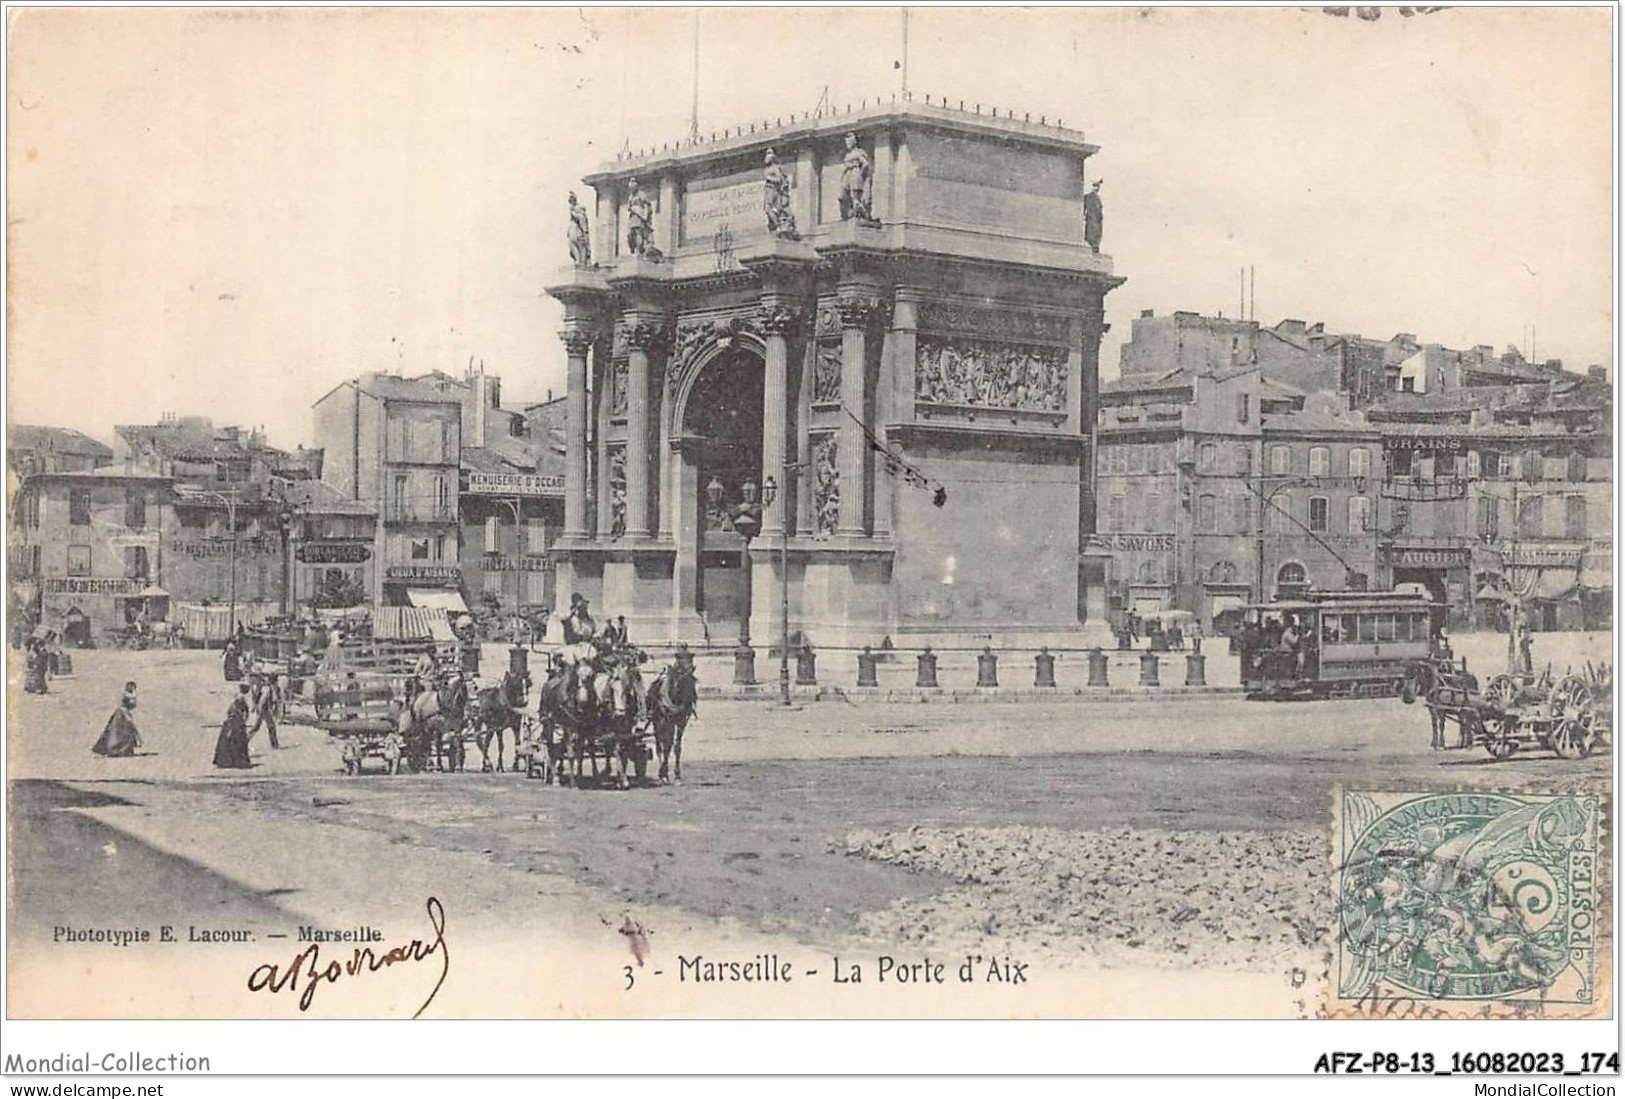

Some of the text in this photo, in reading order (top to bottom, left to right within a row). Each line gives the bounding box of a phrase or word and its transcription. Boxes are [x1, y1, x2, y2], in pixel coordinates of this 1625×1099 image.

[1387, 438, 1461, 450] GRAINS
[471, 474, 522, 487] MENUISERIE
[1117, 536, 1175, 552] SAVONS
[1571, 854, 1593, 945] POSTES
[54, 926, 150, 945] Phototypie
[160, 926, 177, 942] E.
[189, 926, 256, 942] Lacour.
[298, 926, 385, 943] Marseille.
[623, 964, 635, 990] 3
[678, 955, 792, 983] Marseille
[833, 956, 862, 983] La
[878, 955, 945, 984] Porte
[959, 956, 1029, 985] d'Aix
